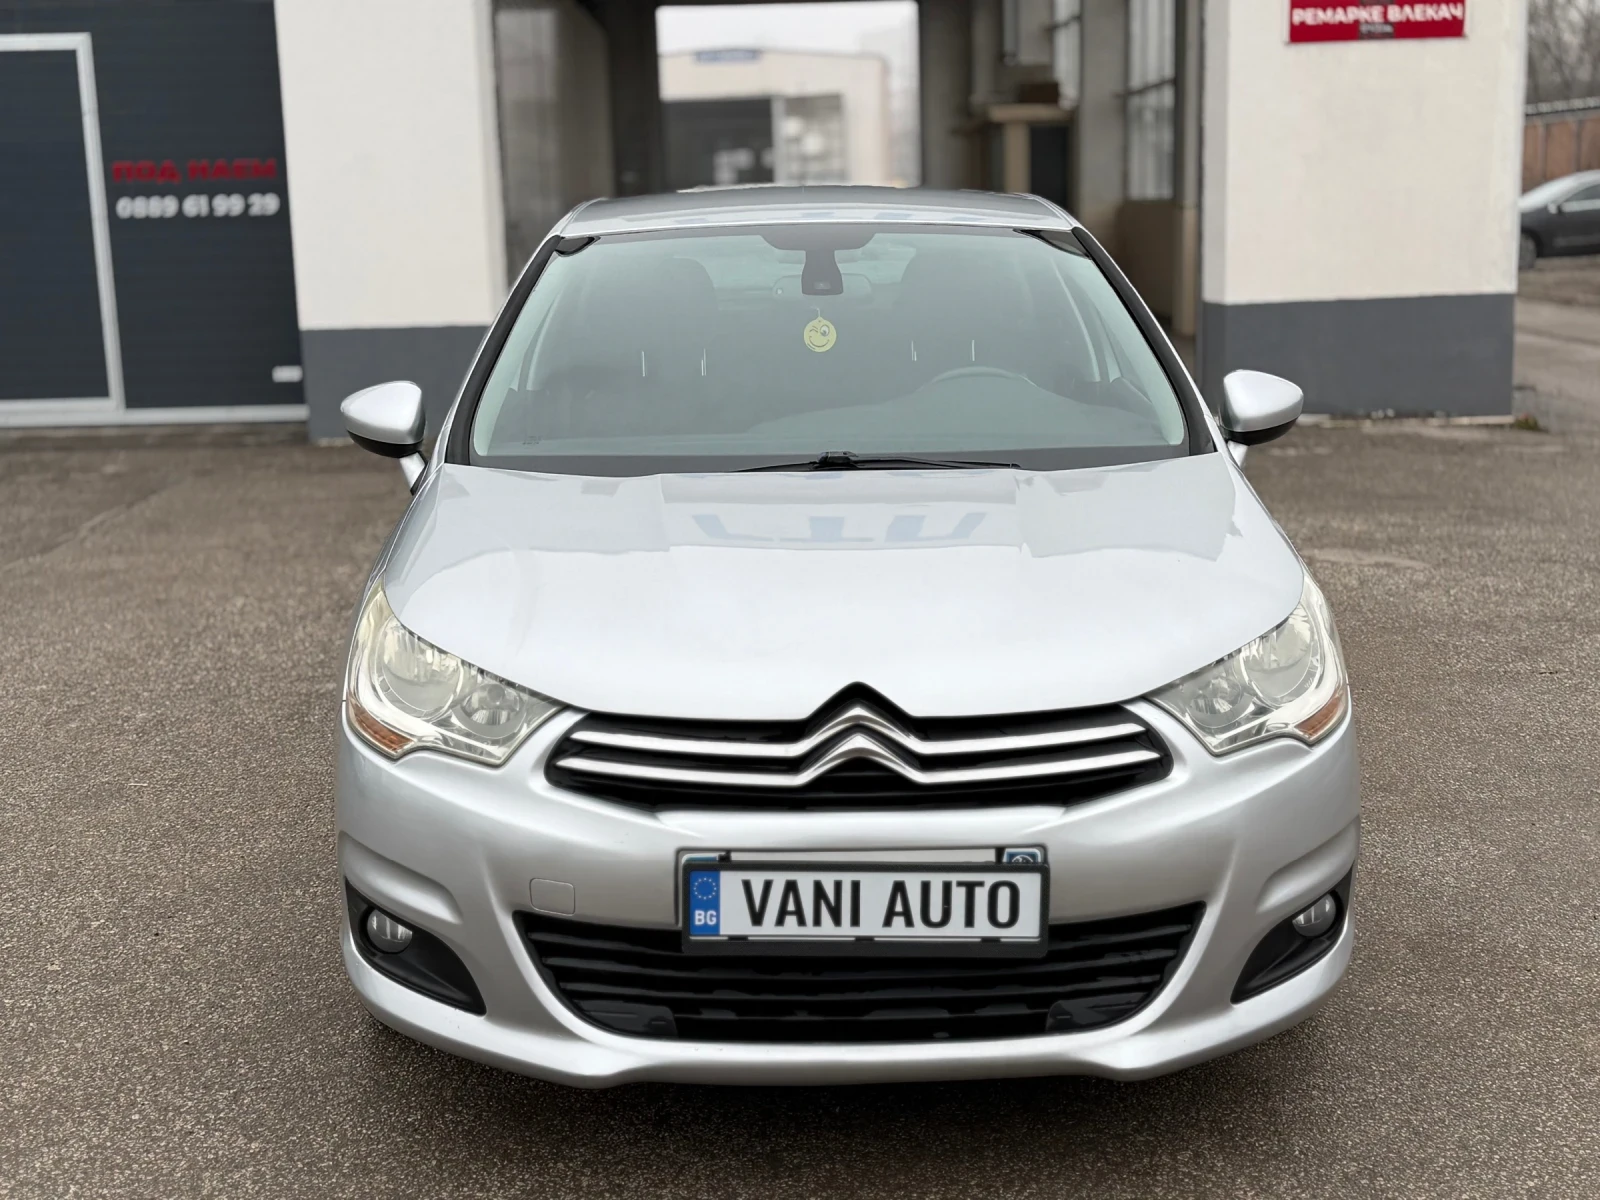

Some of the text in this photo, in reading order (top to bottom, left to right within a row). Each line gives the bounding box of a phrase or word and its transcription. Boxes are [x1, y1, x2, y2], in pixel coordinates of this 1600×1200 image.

[1291, 3, 1464, 25] РЕМАРКЕ ВЛЕКАЧ
[112, 158, 277, 184] ПОД НАЕМ
[182, 194, 210, 218] 61
[741, 879, 1020, 928] VANI AUTO
[694, 910, 717, 926] BG
